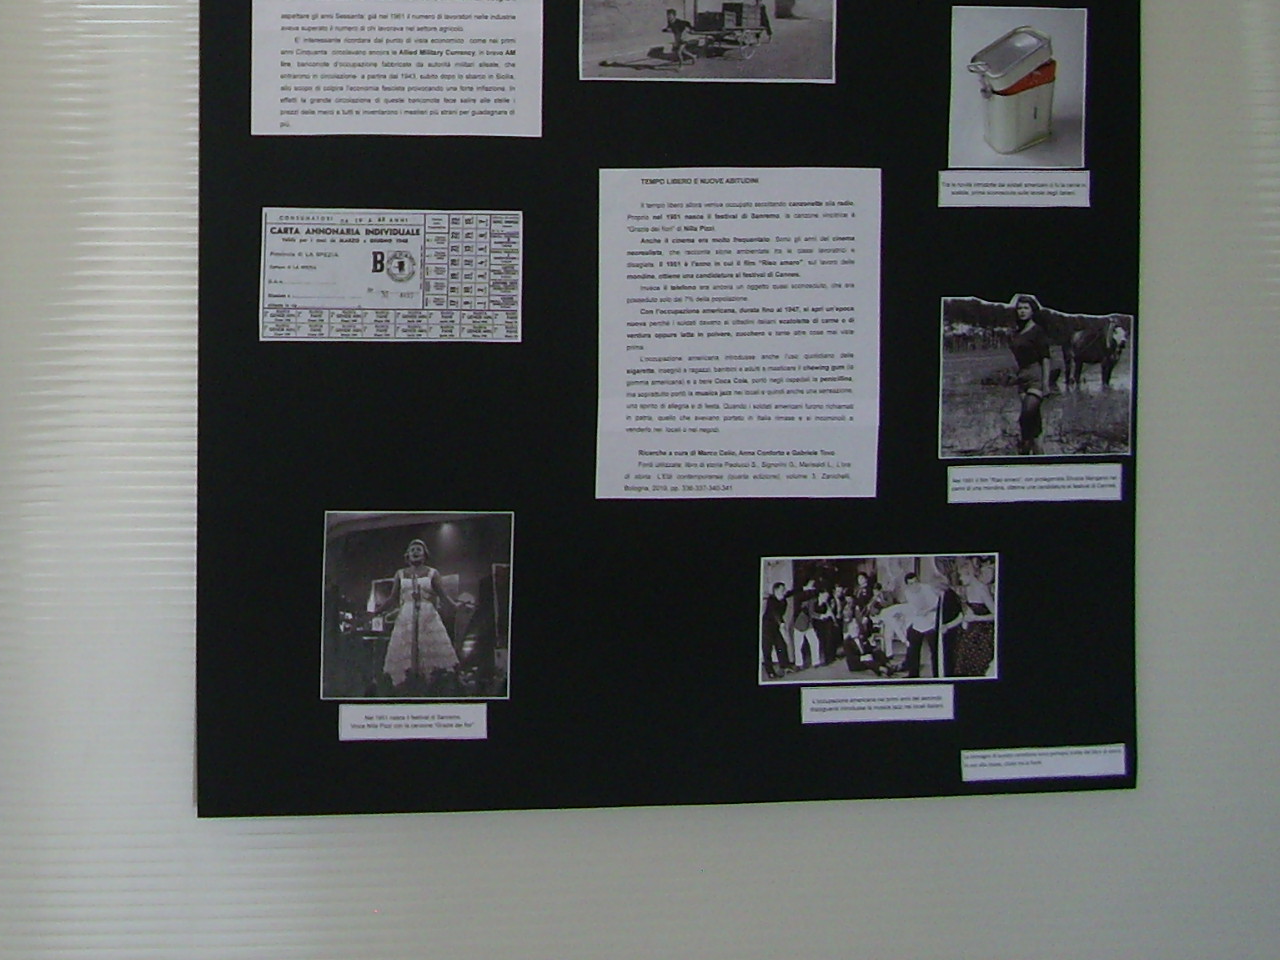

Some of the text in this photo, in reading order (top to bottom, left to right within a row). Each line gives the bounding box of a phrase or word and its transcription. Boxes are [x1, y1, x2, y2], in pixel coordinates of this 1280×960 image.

[269, 226, 421, 236] CARTA ANNONARIA INDIVIDUALE
[371, 250, 385, 273] B
